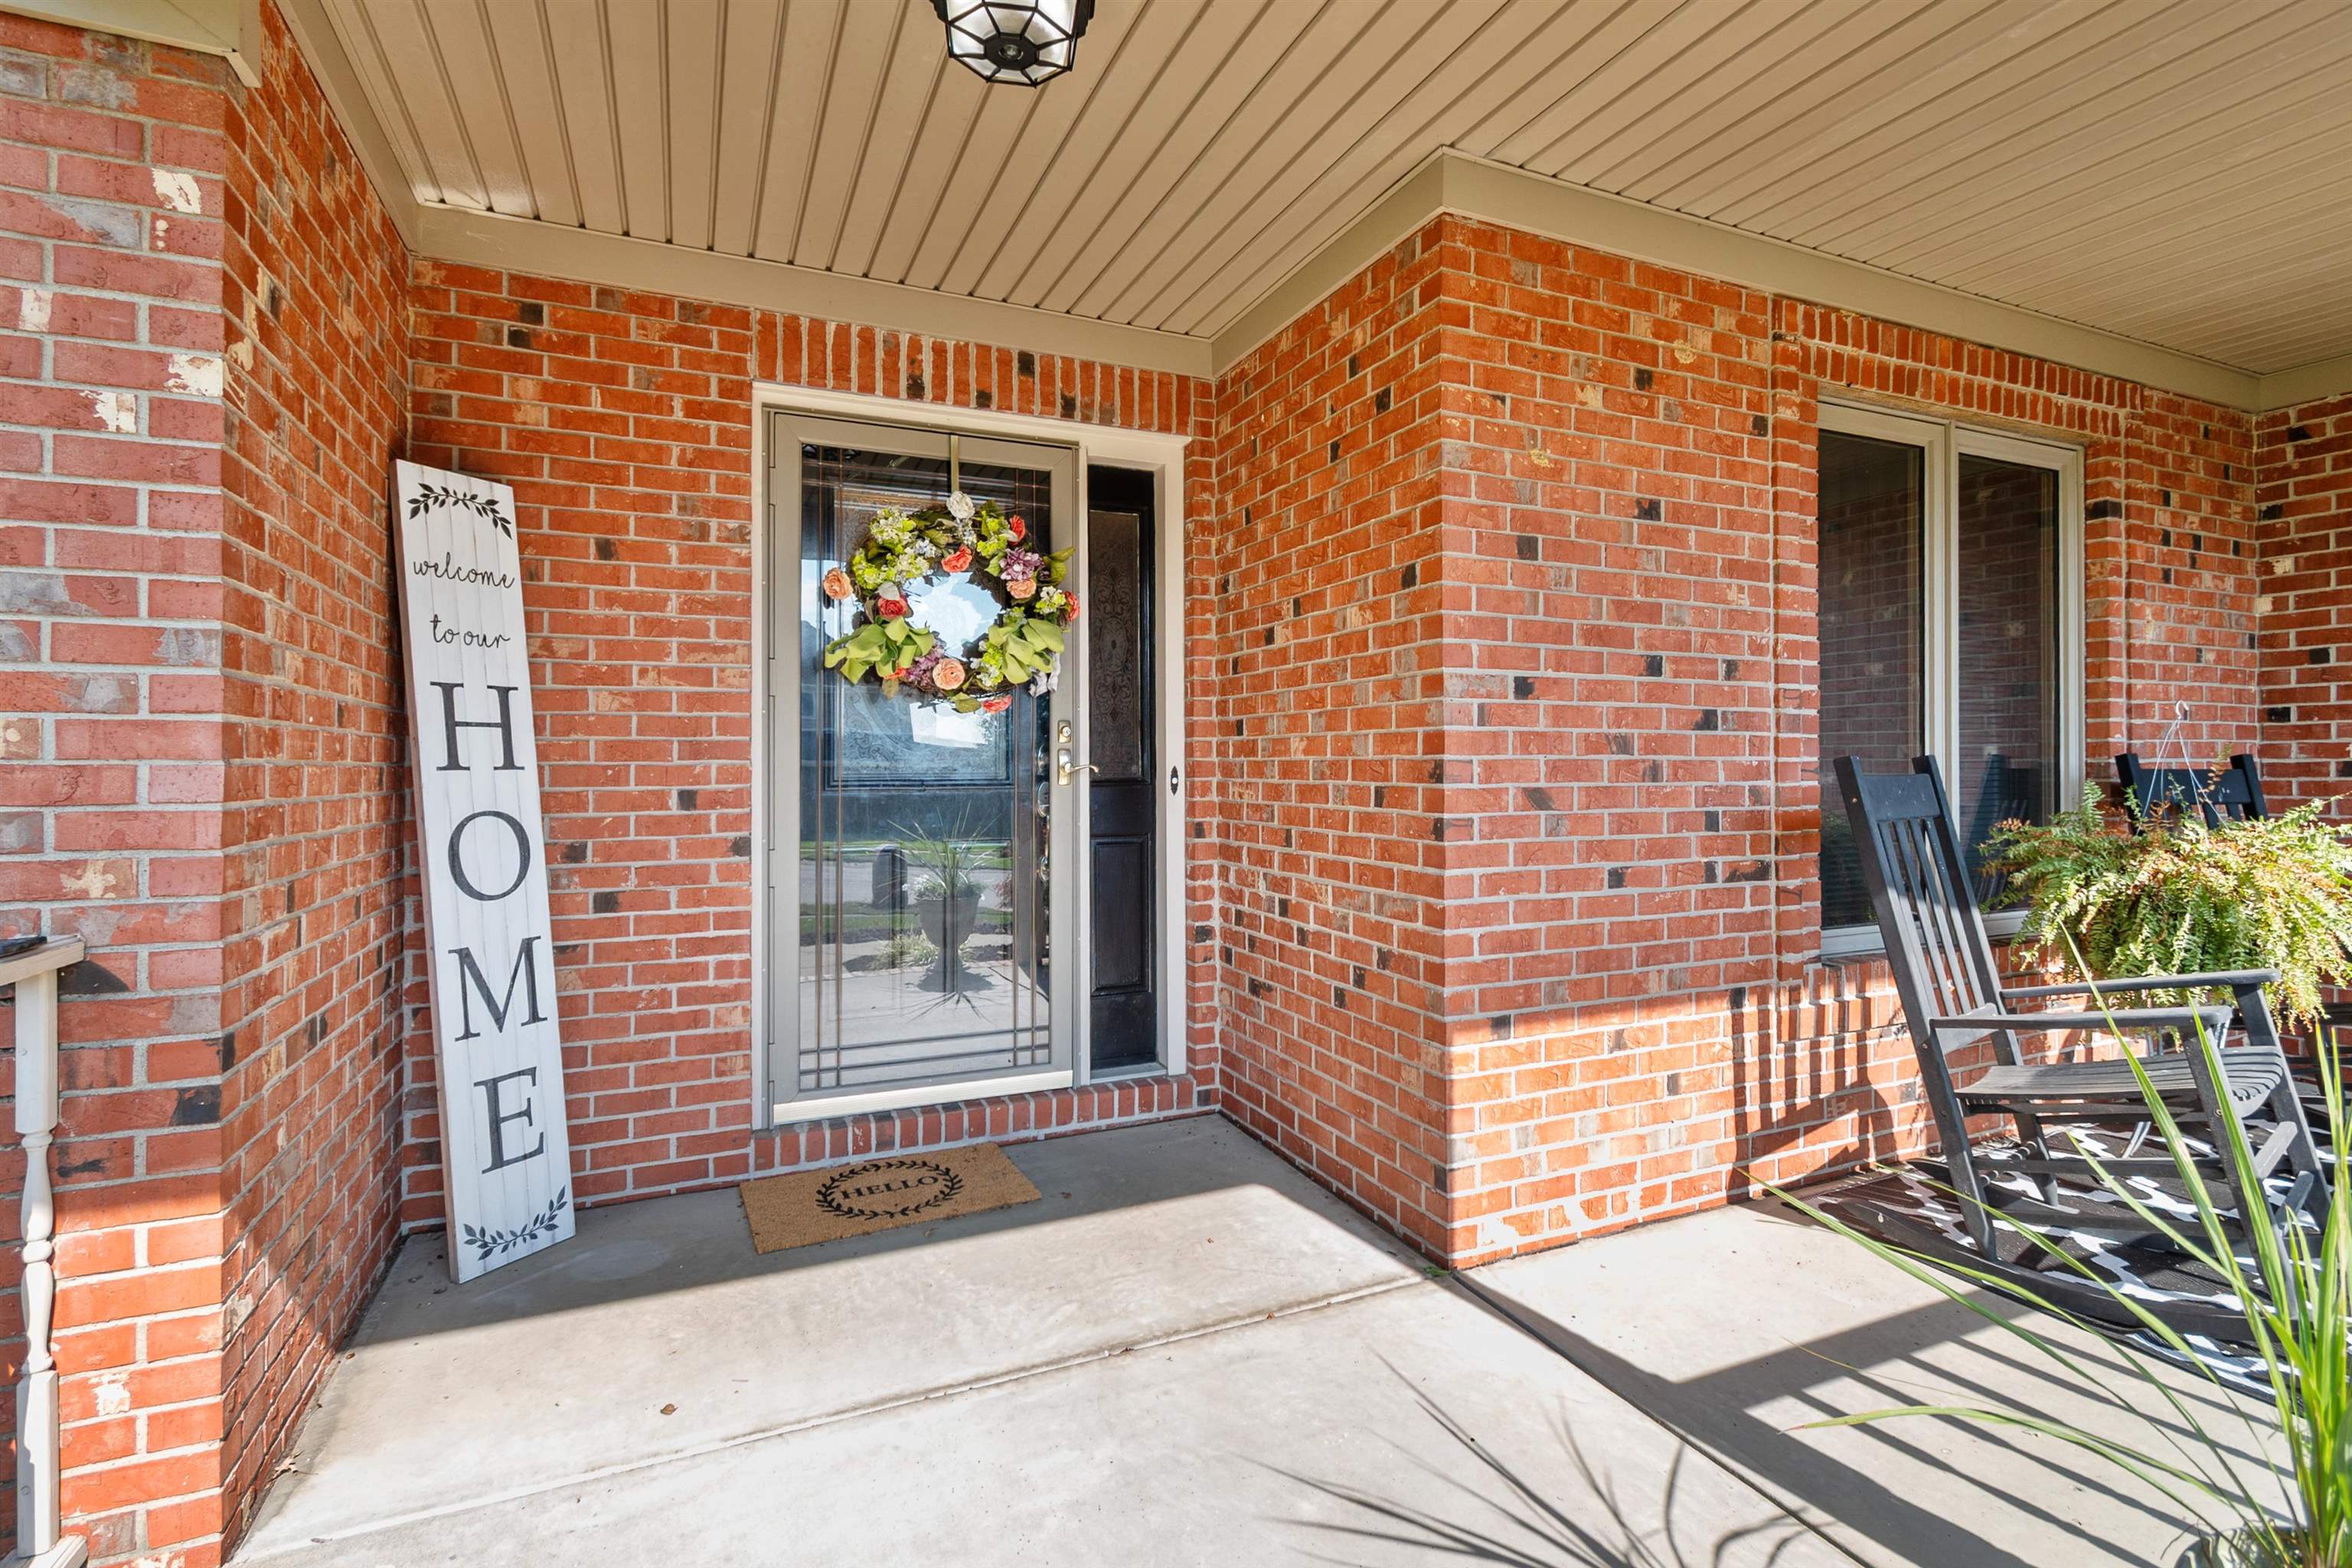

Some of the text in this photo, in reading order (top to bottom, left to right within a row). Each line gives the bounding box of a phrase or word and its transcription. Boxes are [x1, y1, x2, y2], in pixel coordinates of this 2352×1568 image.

[413, 551, 514, 589] welcome
[430, 614, 511, 648] to our
[430, 681, 547, 1174] HOME
[841, 1175, 939, 1200] HELLO
